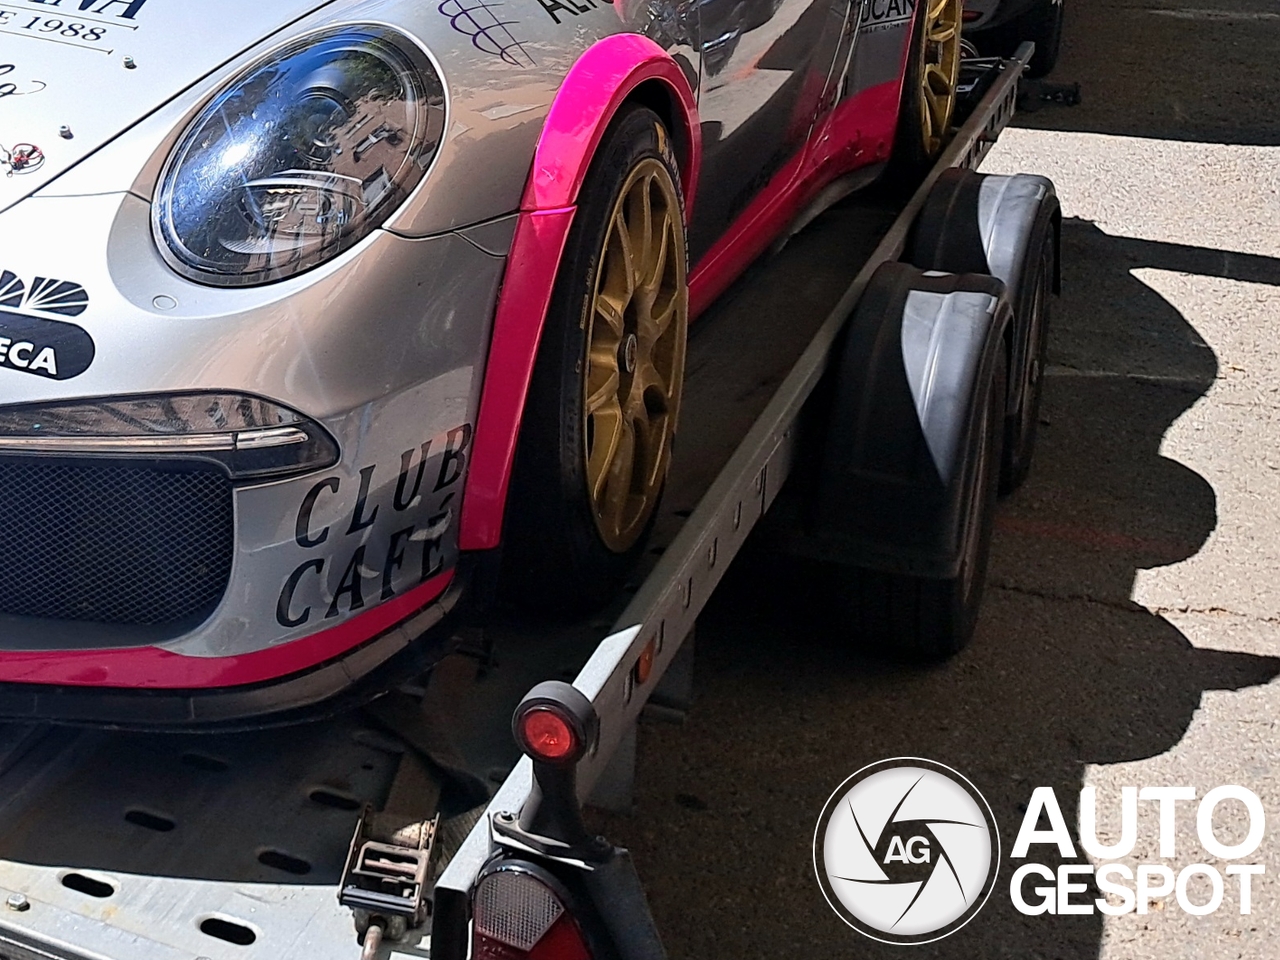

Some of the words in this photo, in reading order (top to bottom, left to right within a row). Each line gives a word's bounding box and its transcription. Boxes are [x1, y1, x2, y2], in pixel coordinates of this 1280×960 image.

[20, 14, 107, 42] 1988
[295, 423, 472, 549] CLUB
[275, 491, 456, 628] CAFÉ
